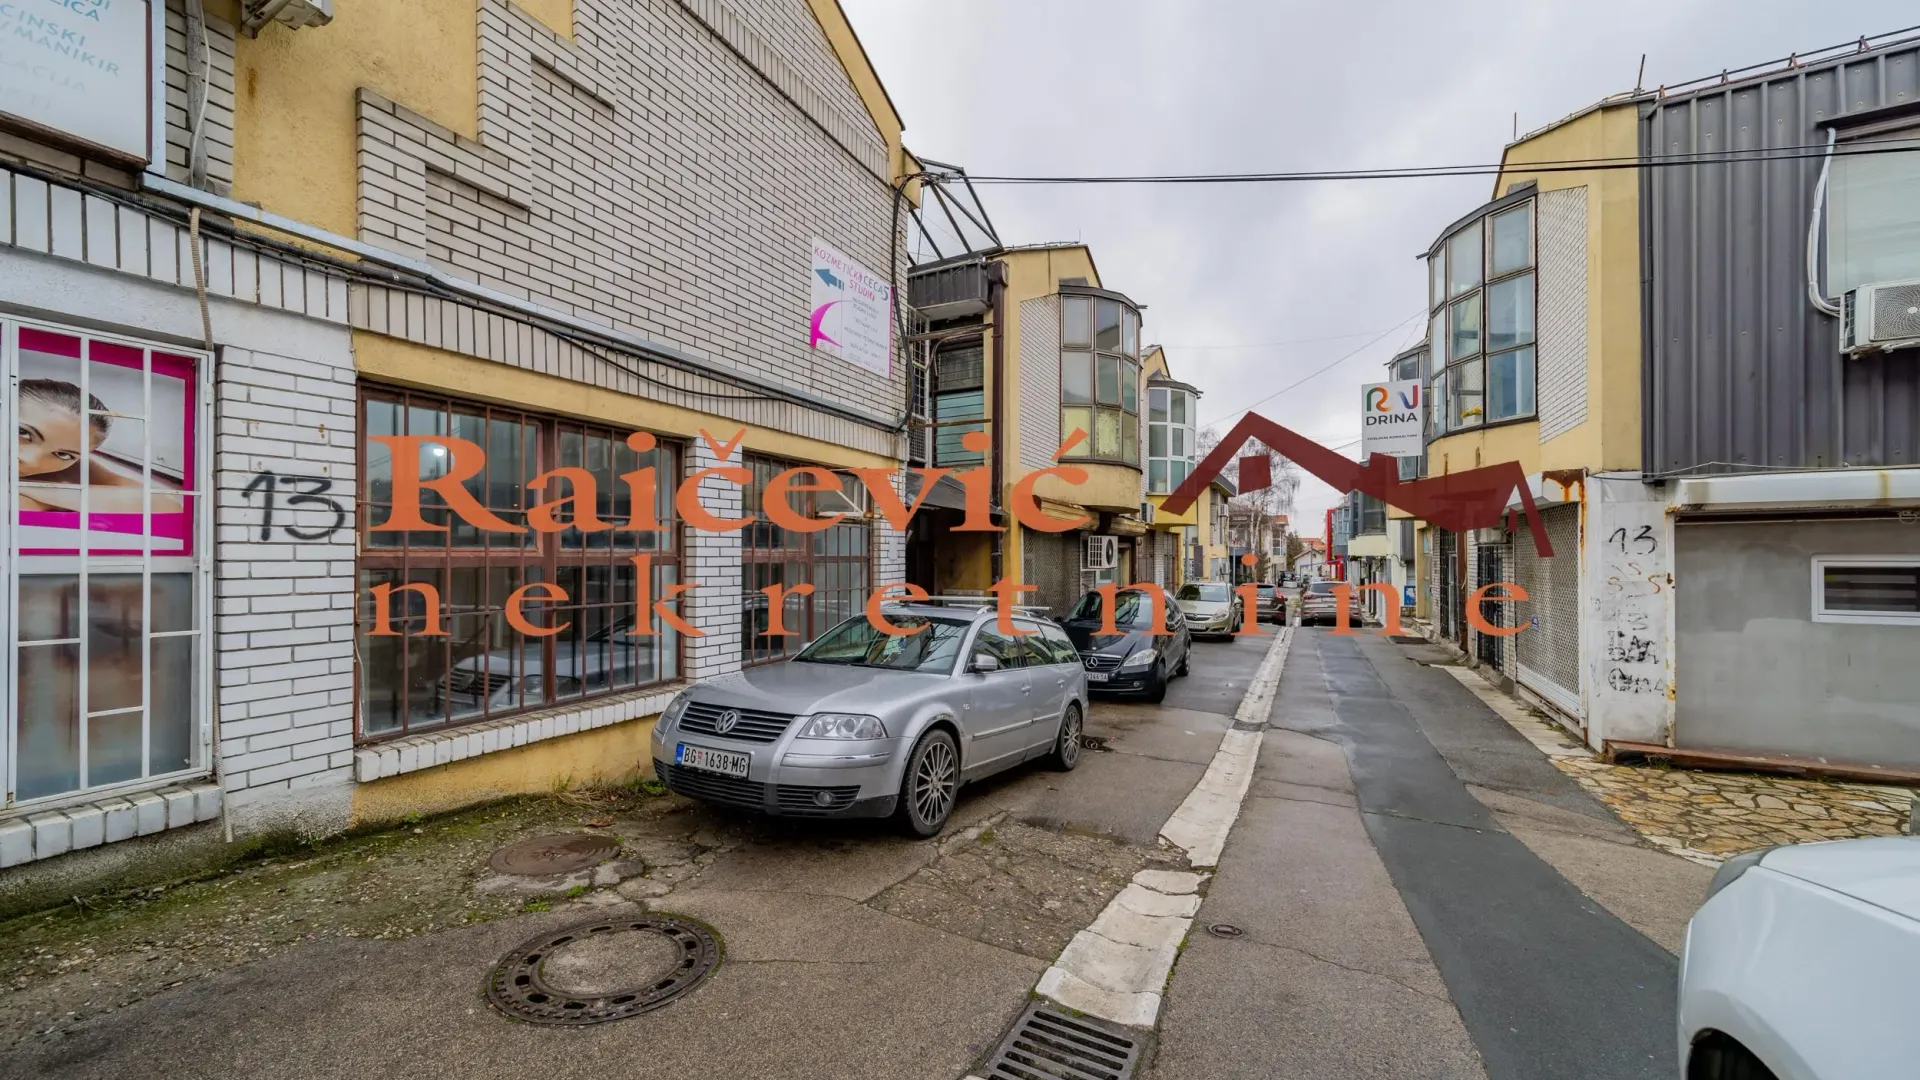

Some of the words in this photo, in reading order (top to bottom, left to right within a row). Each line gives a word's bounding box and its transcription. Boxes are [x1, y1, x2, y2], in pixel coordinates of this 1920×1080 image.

[1366, 412, 1418, 426] DRINA
[241, 470, 346, 541] 13
[1608, 525, 1658, 555] 13
[684, 747, 697, 764] BG
